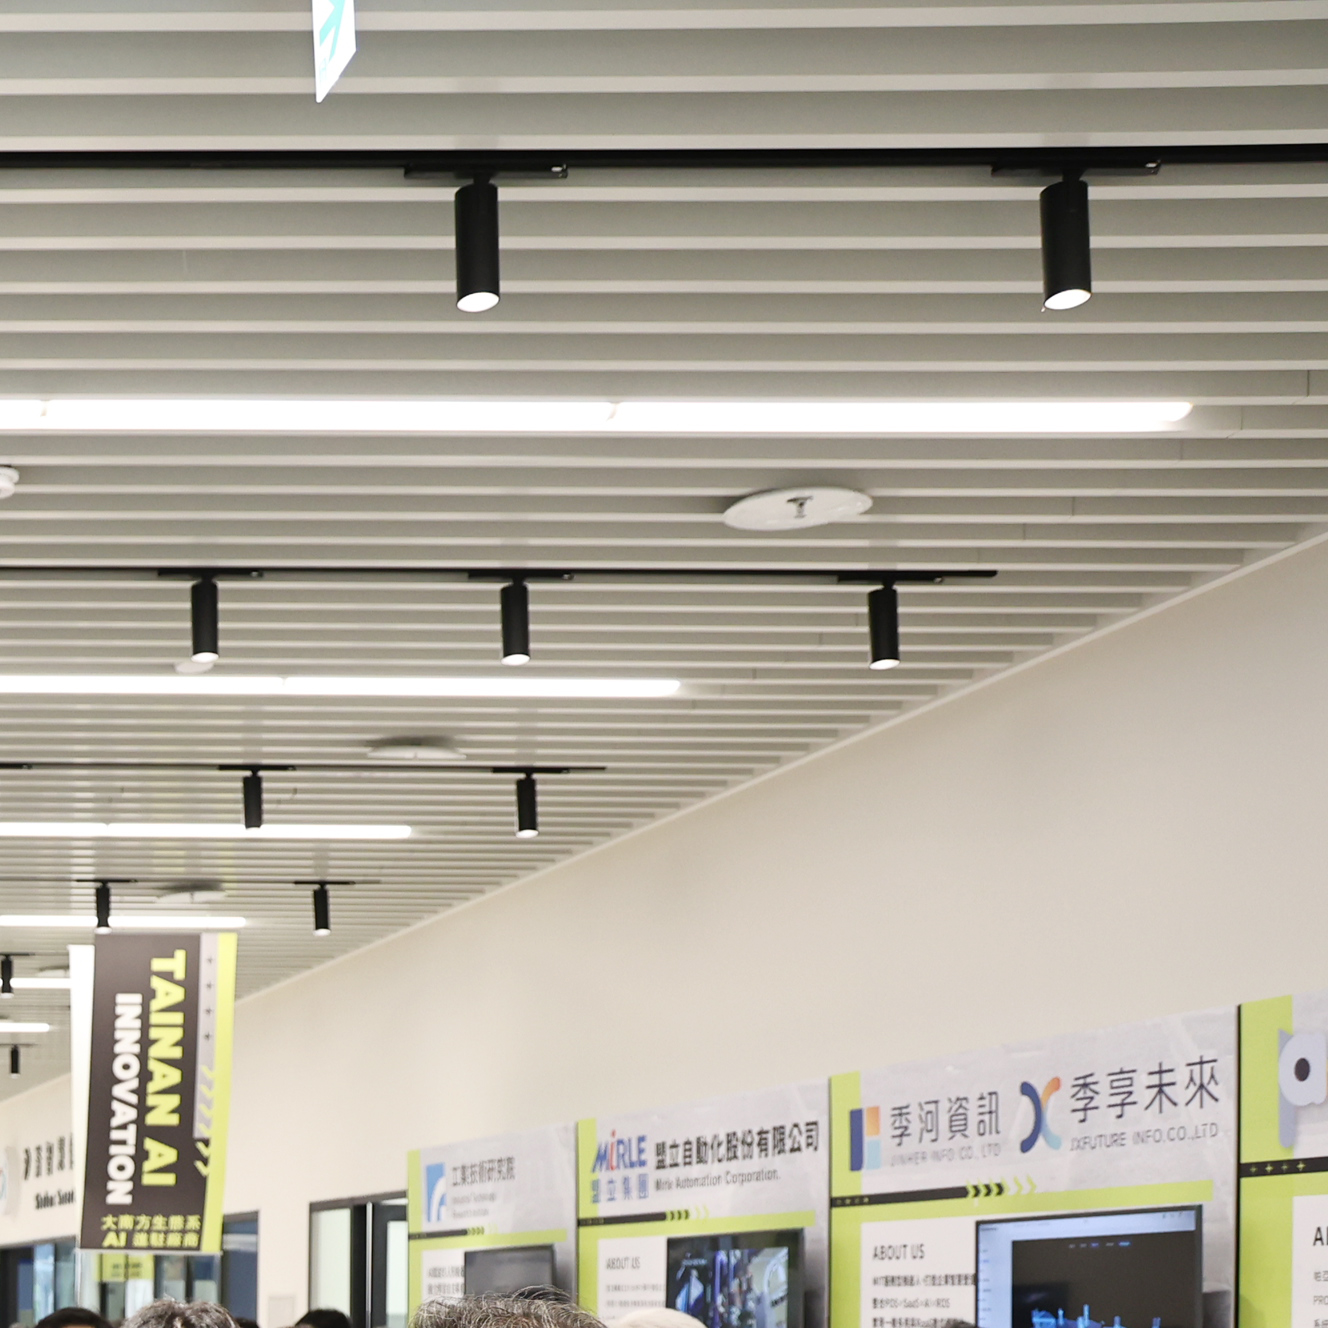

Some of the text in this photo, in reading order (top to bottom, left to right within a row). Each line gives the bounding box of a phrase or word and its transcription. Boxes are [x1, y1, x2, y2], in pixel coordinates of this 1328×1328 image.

[141, 949, 186, 1186] TAINAN AI
[106, 993, 142, 1205] INNOVATION
[1070, 1055, 1219, 1124] 季享未來
[890, 1091, 1000, 1147] 季河資訊
[655, 1121, 819, 1170] 盟立自動化股份有限公司
[452, 1157, 515, 1187] 工業技術研究院
[675, 1173, 722, 1189] Automation
[102, 1231, 127, 1247] AI
[1313, 1226, 1328, 1246] A
[606, 1256, 640, 1269] ABOUT US
[873, 1243, 925, 1260] ABOUT US
